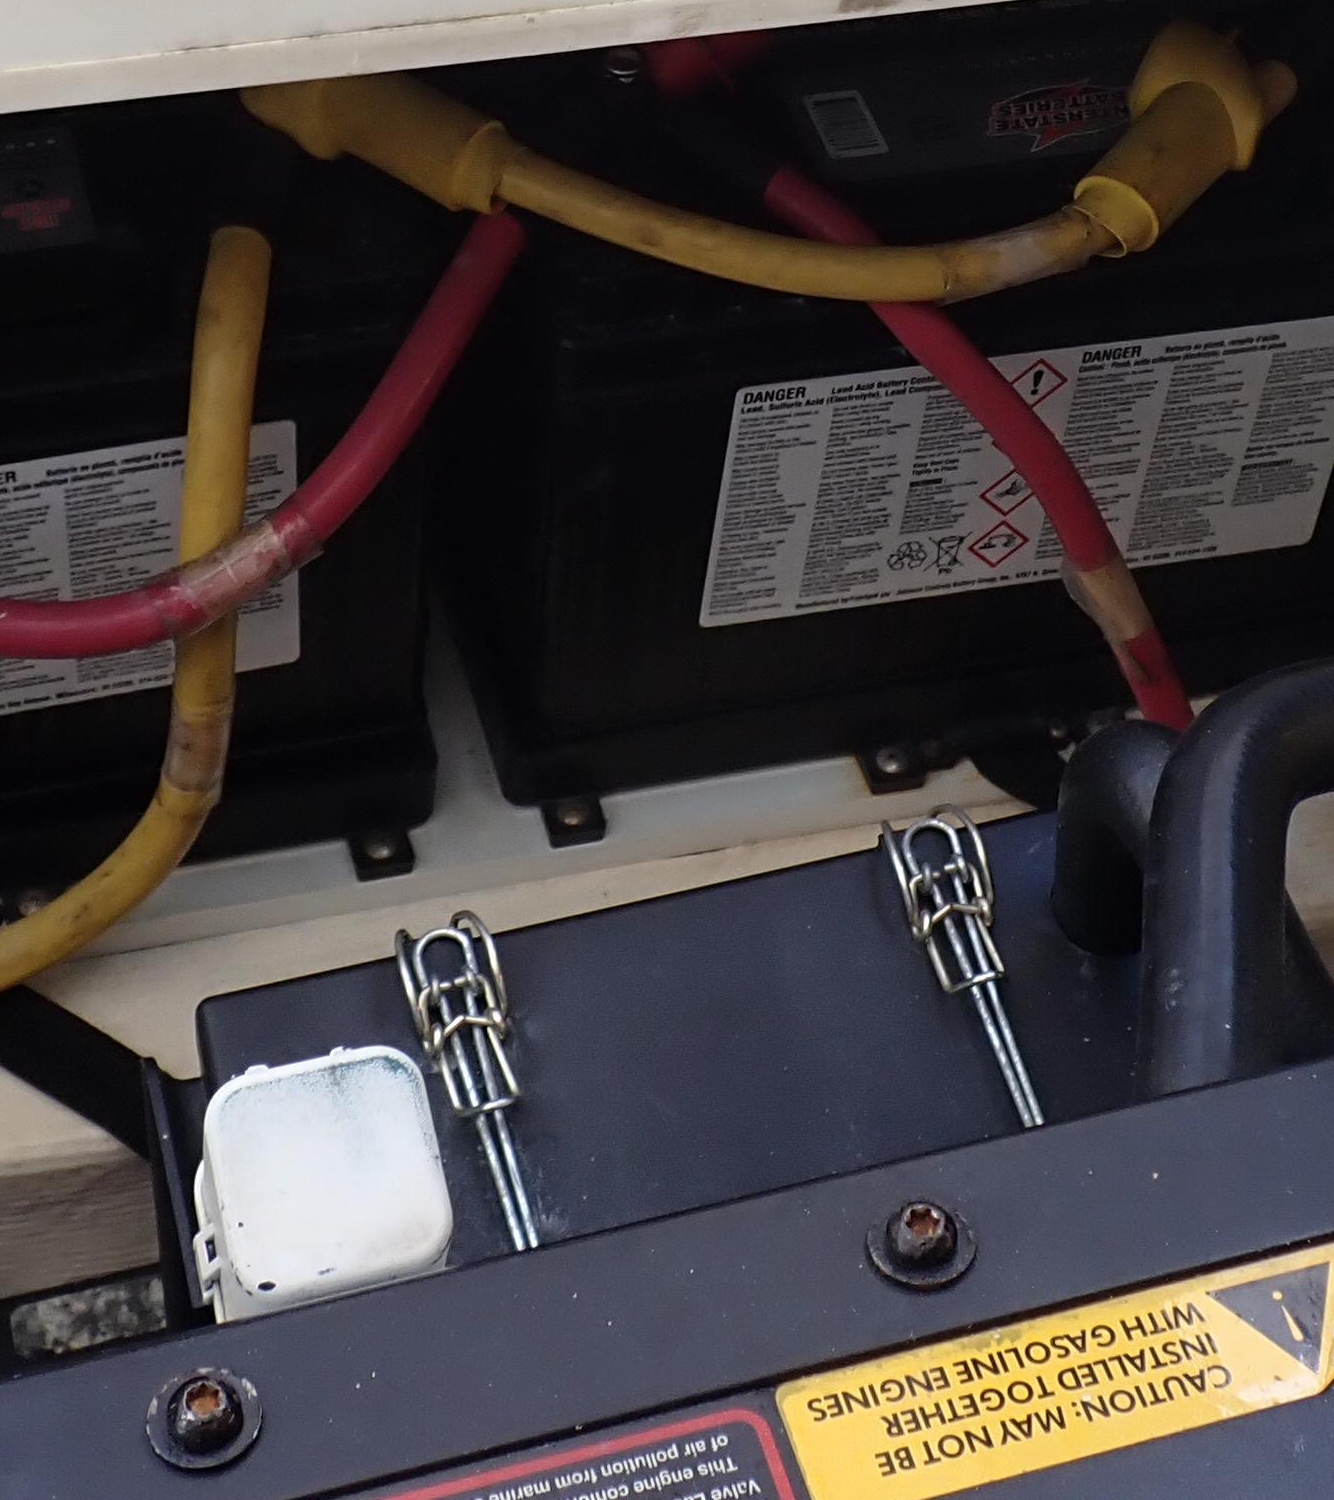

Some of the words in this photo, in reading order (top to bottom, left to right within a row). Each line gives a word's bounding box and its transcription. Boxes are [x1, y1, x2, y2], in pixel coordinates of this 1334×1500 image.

[1082, 345, 1142, 363] DANGER
[743, 386, 807, 404] DANGER
[1119, 1302, 1205, 1341] WITH
[953, 1325, 1116, 1384] GASOLINE
[1058, 1332, 1218, 1391] INSTALLED
[806, 1366, 950, 1423] ENGINES
[881, 1375, 1054, 1438] TOGETHER
[1071, 1364, 1232, 1423] CAUTION:
[1000, 1405, 1066, 1447] MAY
[683, 1439, 708, 1458] air
[709, 1434, 729, 1452] of
[918, 1426, 993, 1465] NOT
[599, 1443, 679, 1479] pollution
[696, 1455, 739, 1476] This
[875, 1446, 915, 1476] BE
[488, 1479, 551, 1500] marine
[553, 1467, 598, 1490] from
[632, 1467, 695, 1494] engine
[710, 1478, 762, 1500] Valve
